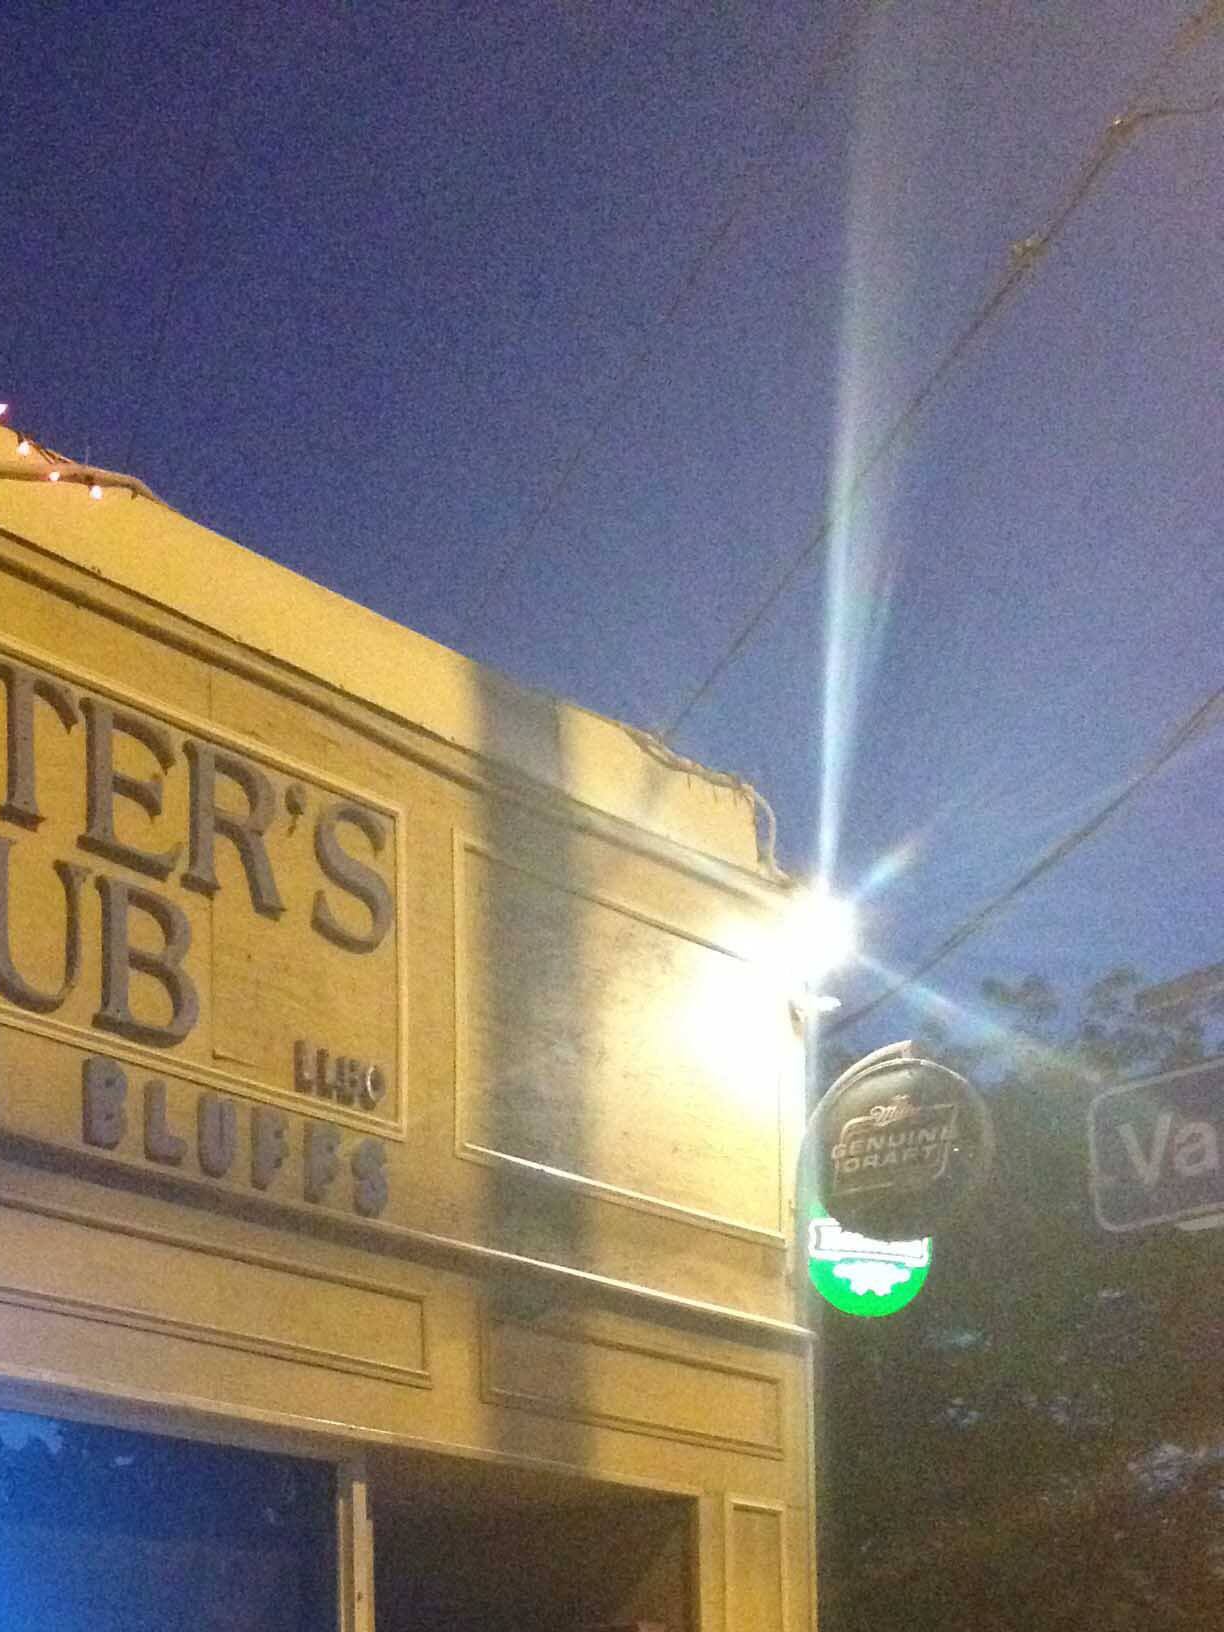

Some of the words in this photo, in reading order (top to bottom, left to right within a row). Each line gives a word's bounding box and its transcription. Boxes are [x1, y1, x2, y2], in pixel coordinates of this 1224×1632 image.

[81, 1056, 390, 1217] BLUFFS
[831, 1124, 958, 1160] GENUINE
[842, 1144, 938, 1173] DRAFT
